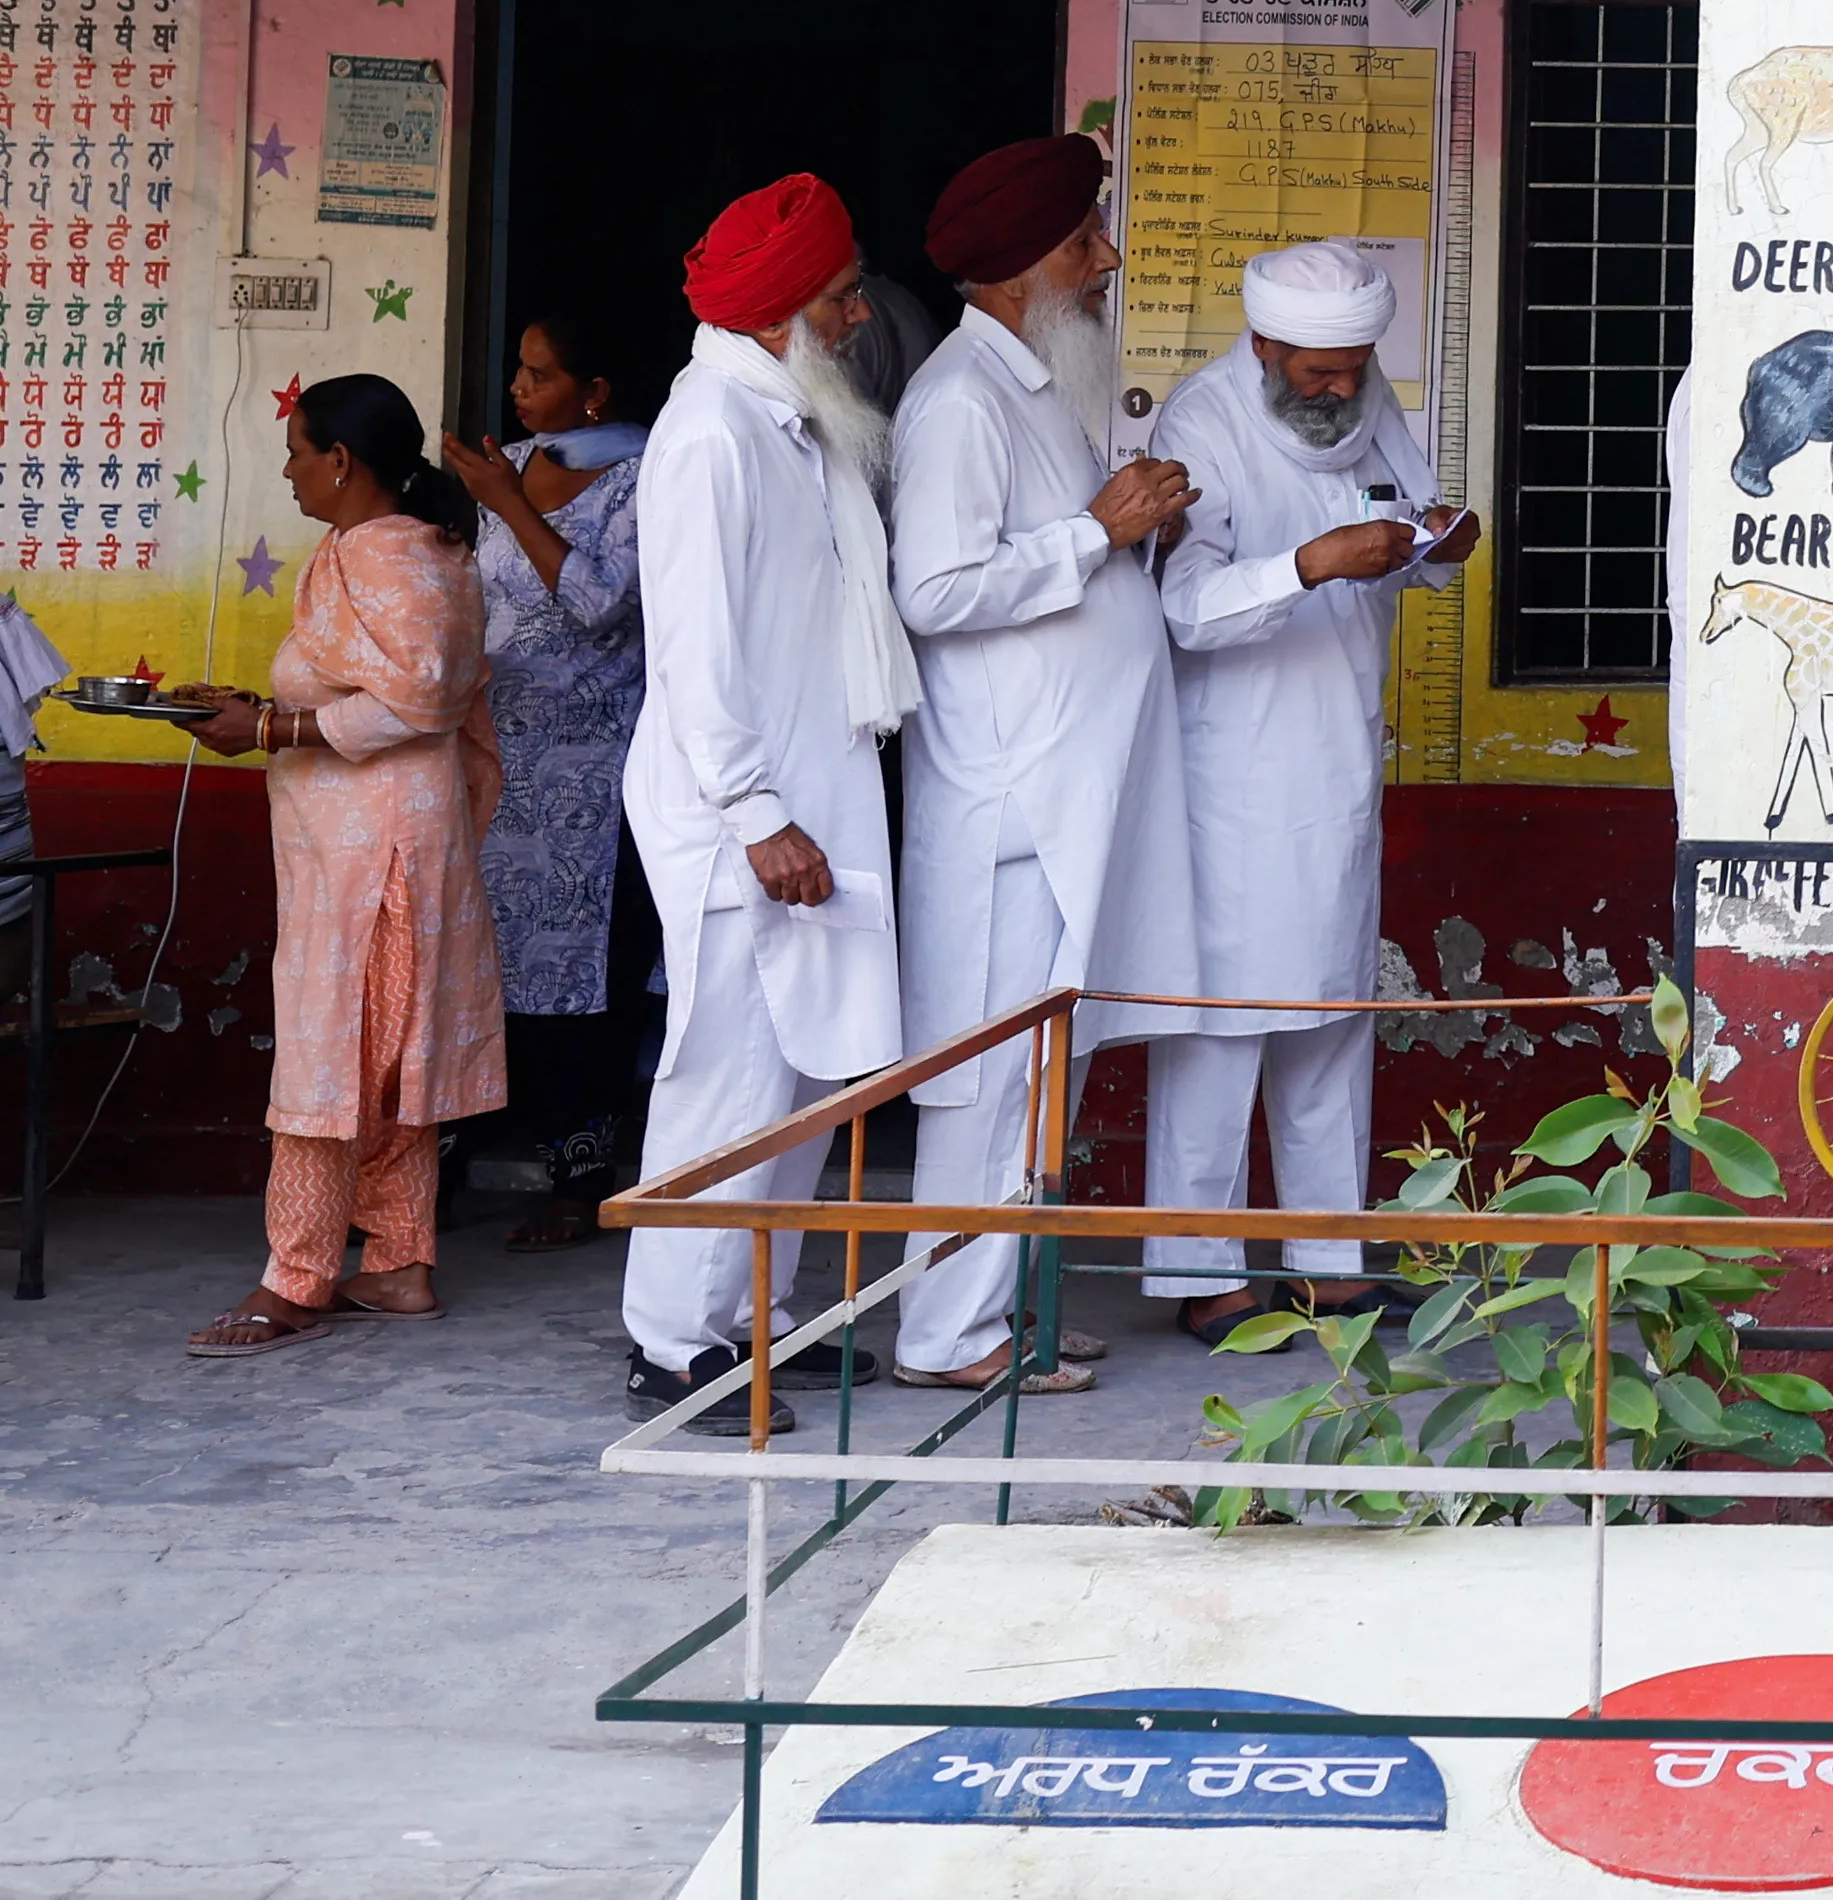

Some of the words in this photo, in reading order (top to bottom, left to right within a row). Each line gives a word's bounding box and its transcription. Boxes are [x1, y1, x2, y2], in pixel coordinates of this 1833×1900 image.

[1202, 11, 1254, 25] ELECTION
[1256, 12, 1321, 26] COMMISSION
[1323, 14, 1339, 26] OF
[1340, 14, 1369, 28] INDIA
[1732, 512, 1831, 566] BEAR
